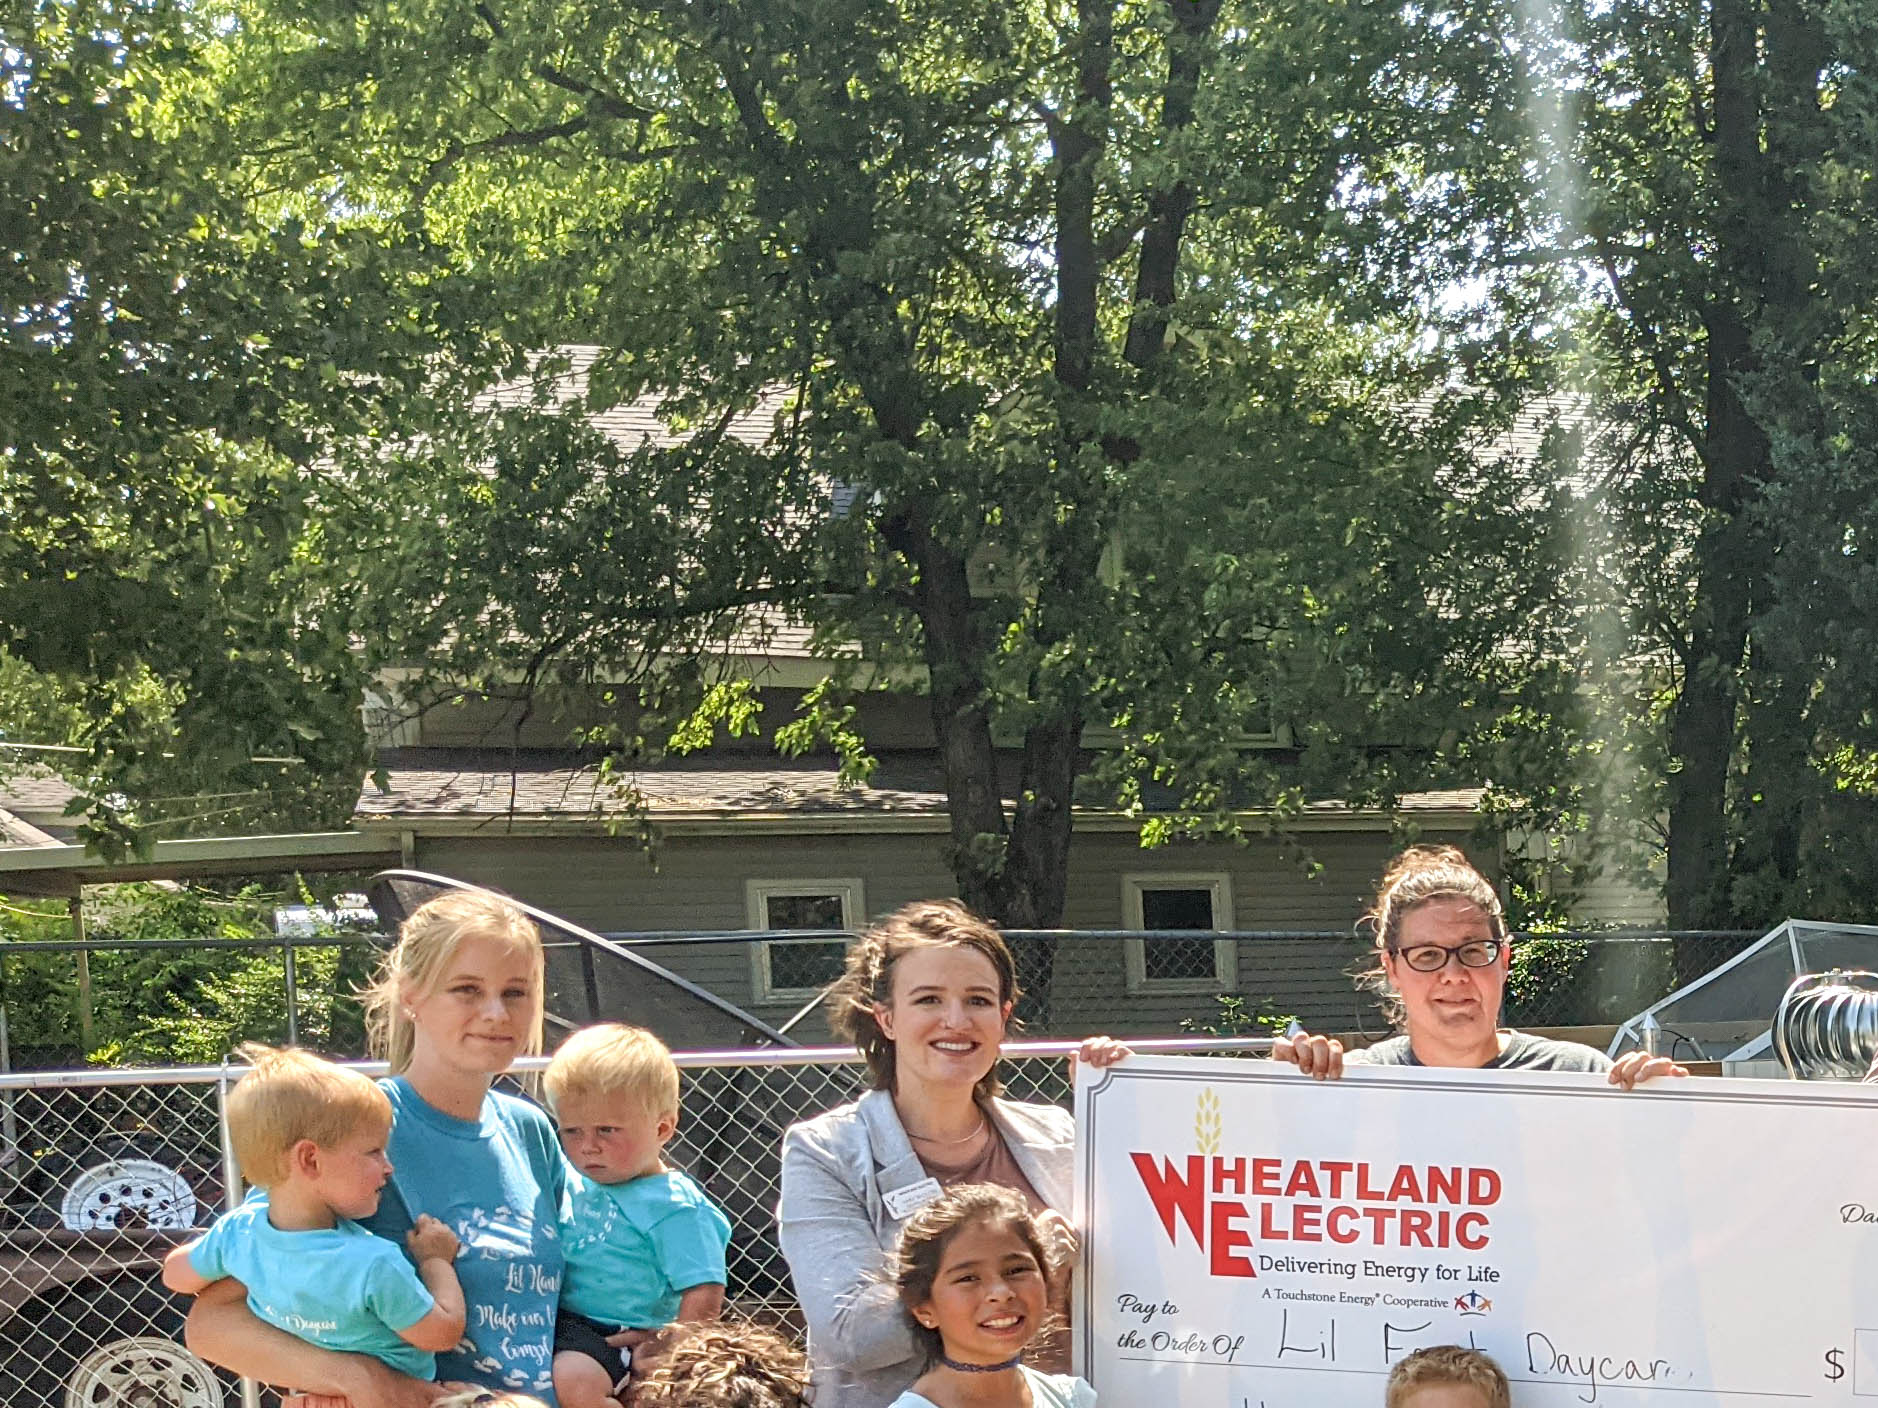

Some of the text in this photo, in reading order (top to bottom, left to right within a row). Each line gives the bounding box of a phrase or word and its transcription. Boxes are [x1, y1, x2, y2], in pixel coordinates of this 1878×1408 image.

[1129, 1151, 1502, 1255] WHEATLAND
[1210, 1200, 1490, 1278] ELECTRIC
[1259, 1254, 1500, 1283] Delivering Energy for Life
[1117, 1293, 1179, 1324] Pay to
[1261, 1288, 1271, 1299] A
[1274, 1288, 1336, 1303] Touchstone
[1383, 1293, 1449, 1309] Cooperative
[500, 1335, 552, 1366] Compl
[1117, 1330, 1245, 1363] the Order Of
[1277, 1308, 1336, 1362] Lil
[1526, 1331, 1692, 1403] Daycar
[1824, 1347, 1846, 1383] $
